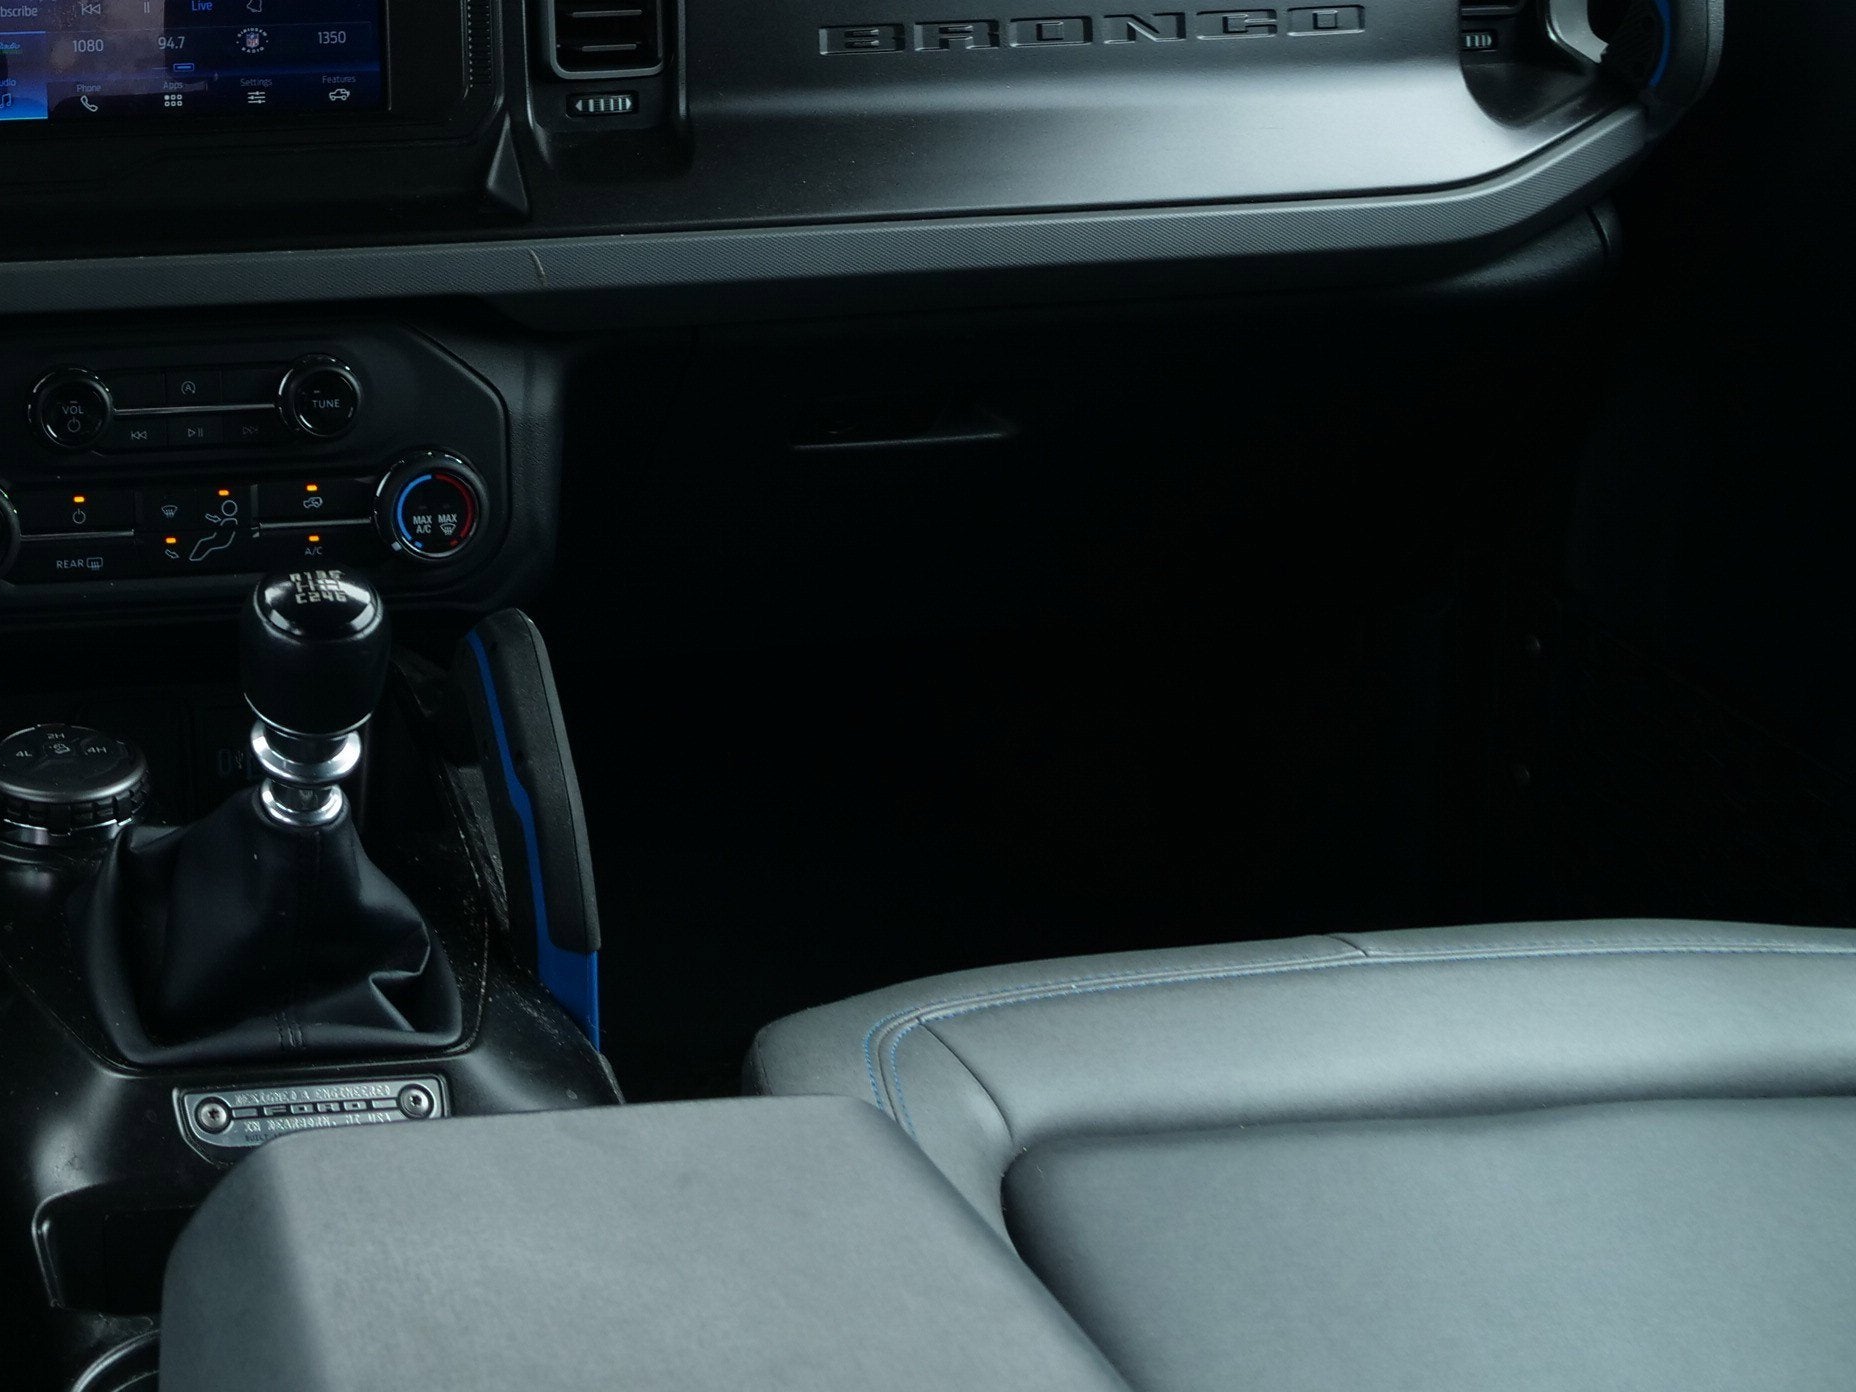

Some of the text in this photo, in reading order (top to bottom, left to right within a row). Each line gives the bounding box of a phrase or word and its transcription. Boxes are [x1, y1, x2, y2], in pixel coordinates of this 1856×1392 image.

[191, 0, 214, 12] Live
[818, 4, 1366, 57] BRONCO
[157, 36, 186, 50] 94.7
[318, 31, 347, 45] 1350
[73, 39, 104, 53] 1080
[240, 78, 273, 89] Settings
[321, 75, 357, 85] Features
[76, 84, 102, 93] Phone
[163, 81, 183, 91] Apps
[312, 399, 341, 408] TUNE
[62, 406, 85, 415] VOL
[413, 515, 432, 524] MAX
[438, 514, 458, 523] MAX
[416, 525, 432, 534] A/C
[304, 546, 324, 556] A/C
[56, 560, 84, 569] REAR
[16, 750, 32, 758] 4L
[87, 746, 107, 755] 4H
[316, 1085, 392, 1099] ENGINEERED
[263, 1099, 366, 1116] FORD
